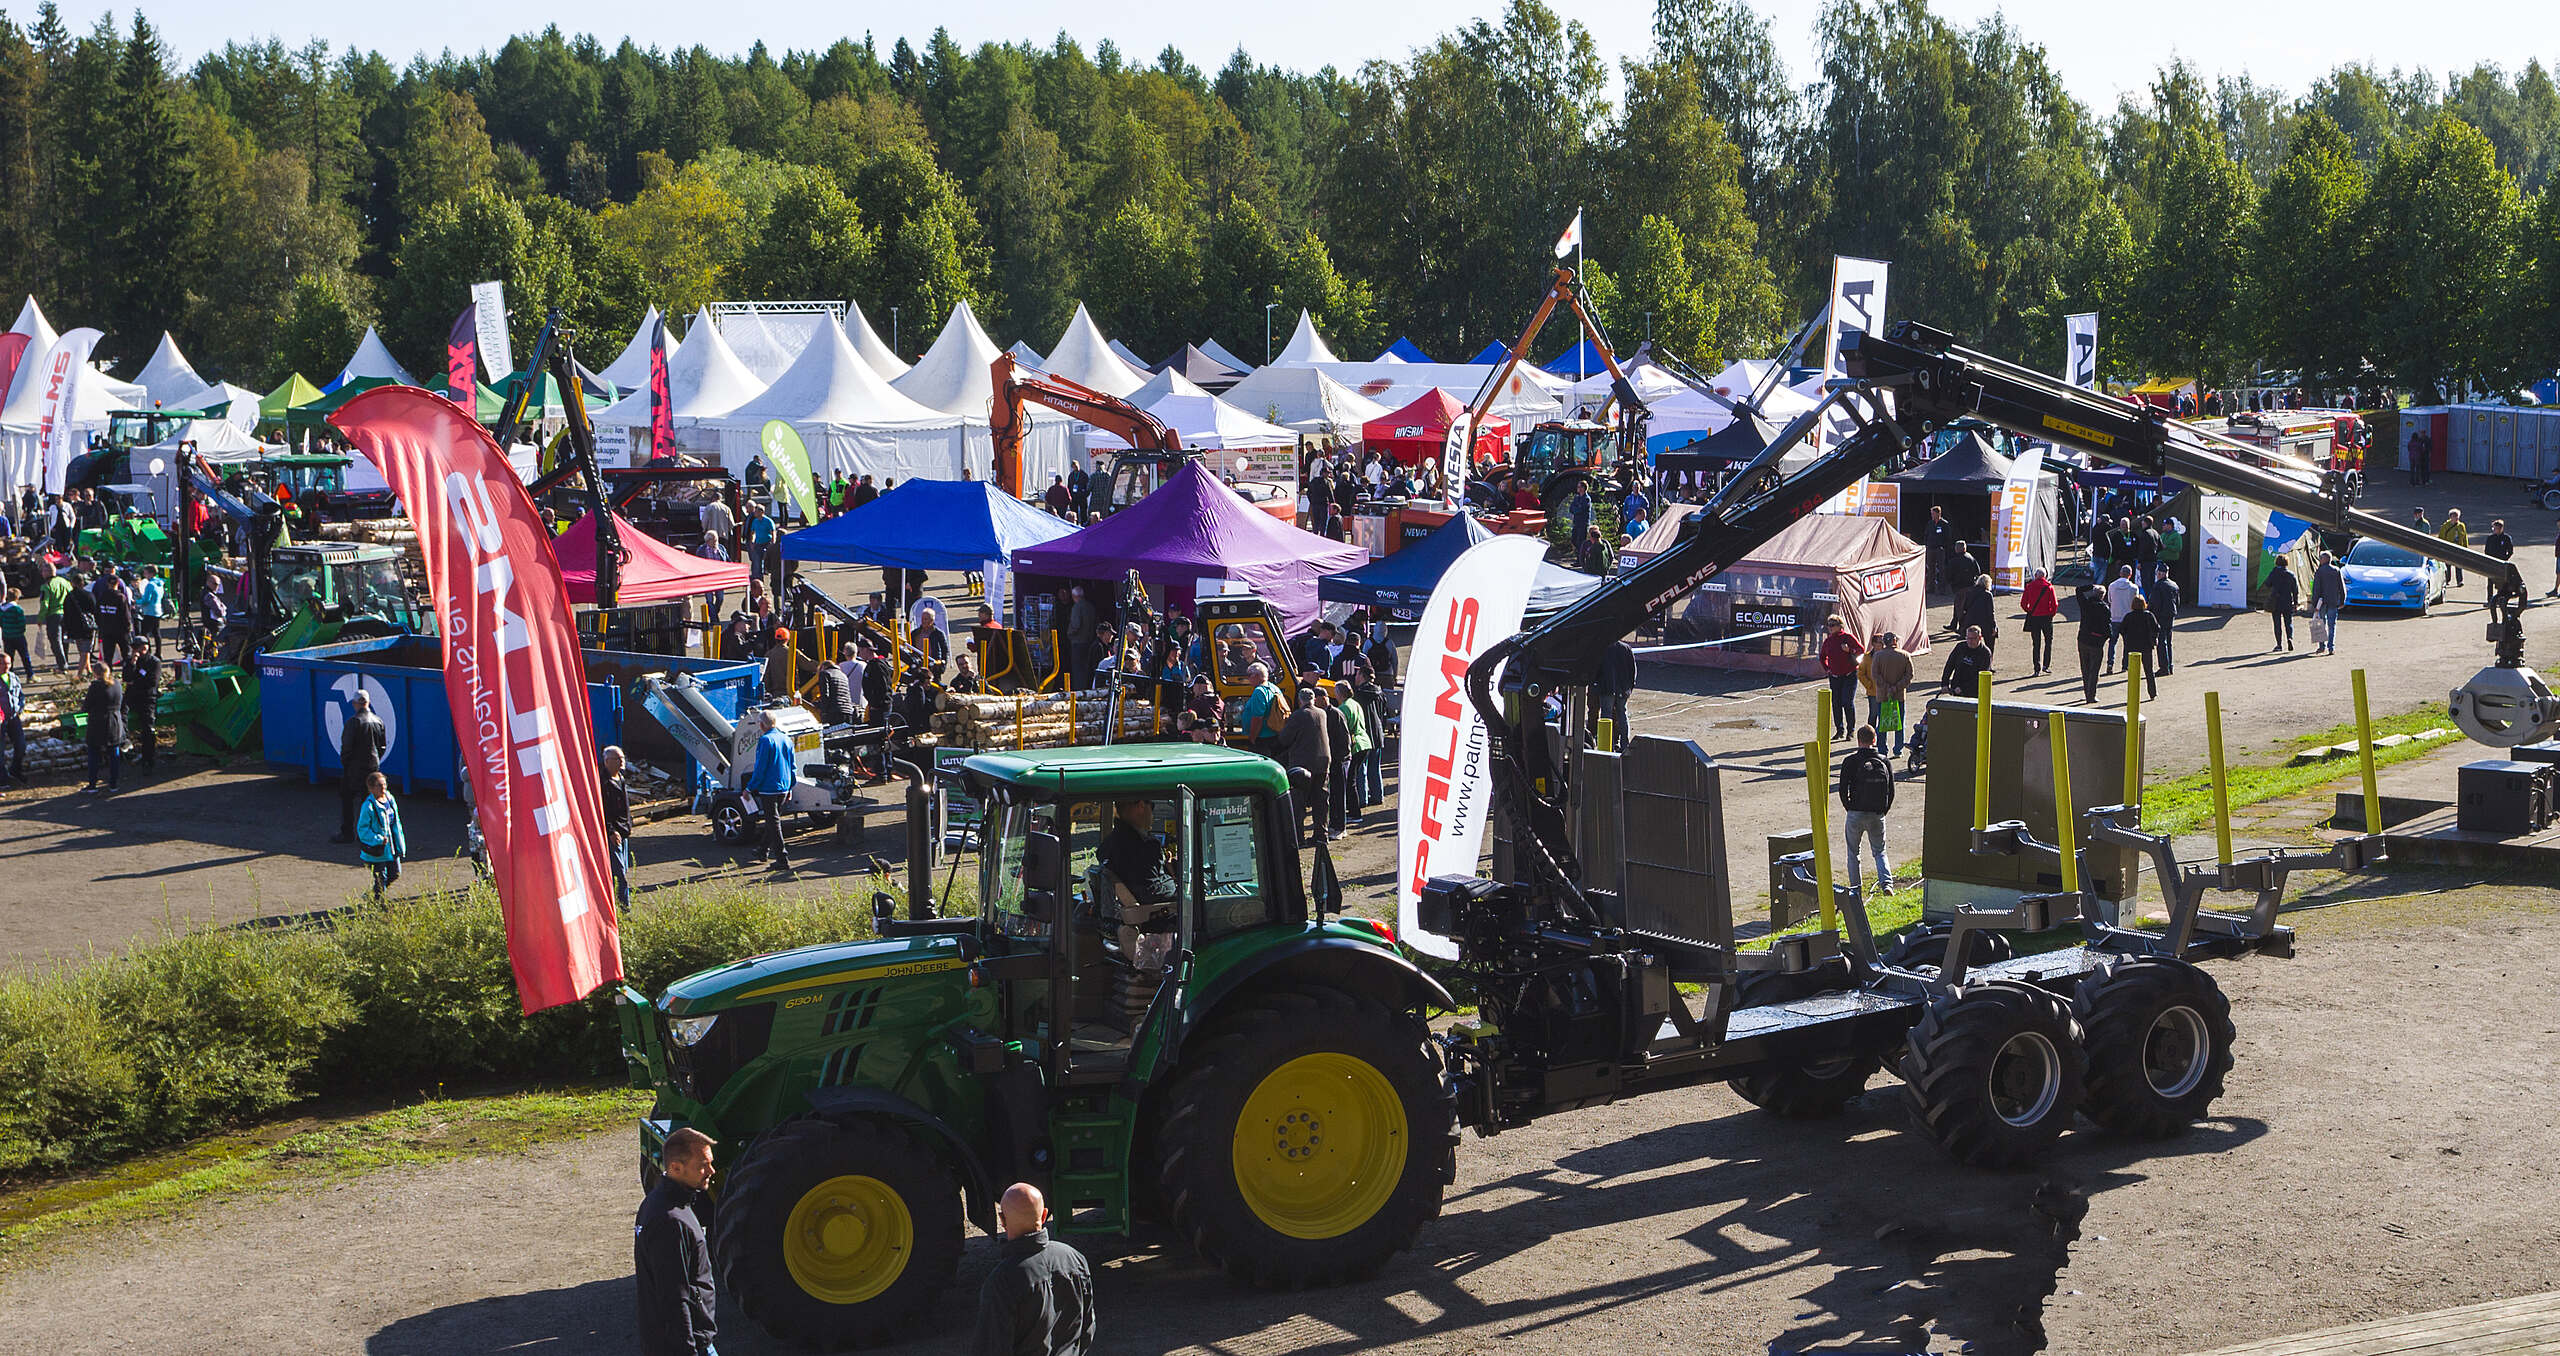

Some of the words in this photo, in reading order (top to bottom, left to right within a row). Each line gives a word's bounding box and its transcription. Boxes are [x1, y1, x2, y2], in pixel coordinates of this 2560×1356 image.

[1043, 394, 1079, 412] HITACHI
[1447, 425, 1465, 499] KESLA
[2208, 506, 2240, 521] Kiho
[1404, 527, 1428, 537] NEVA
[1621, 556, 1637, 567] 425
[1645, 561, 1719, 613] PALMS
[1864, 572, 1894, 595] NEVA
[1383, 591, 1400, 600] MPK
[1735, 611, 1796, 625] ECOAIMS
[262, 666, 284, 677] 13016
[725, 679, 745, 690] 13016
[1411, 597, 1480, 898] PALMS
[1209, 805, 1248, 817] Hankkija
[883, 966, 914, 977] JOHN
[914, 962, 950, 974] DEERE
